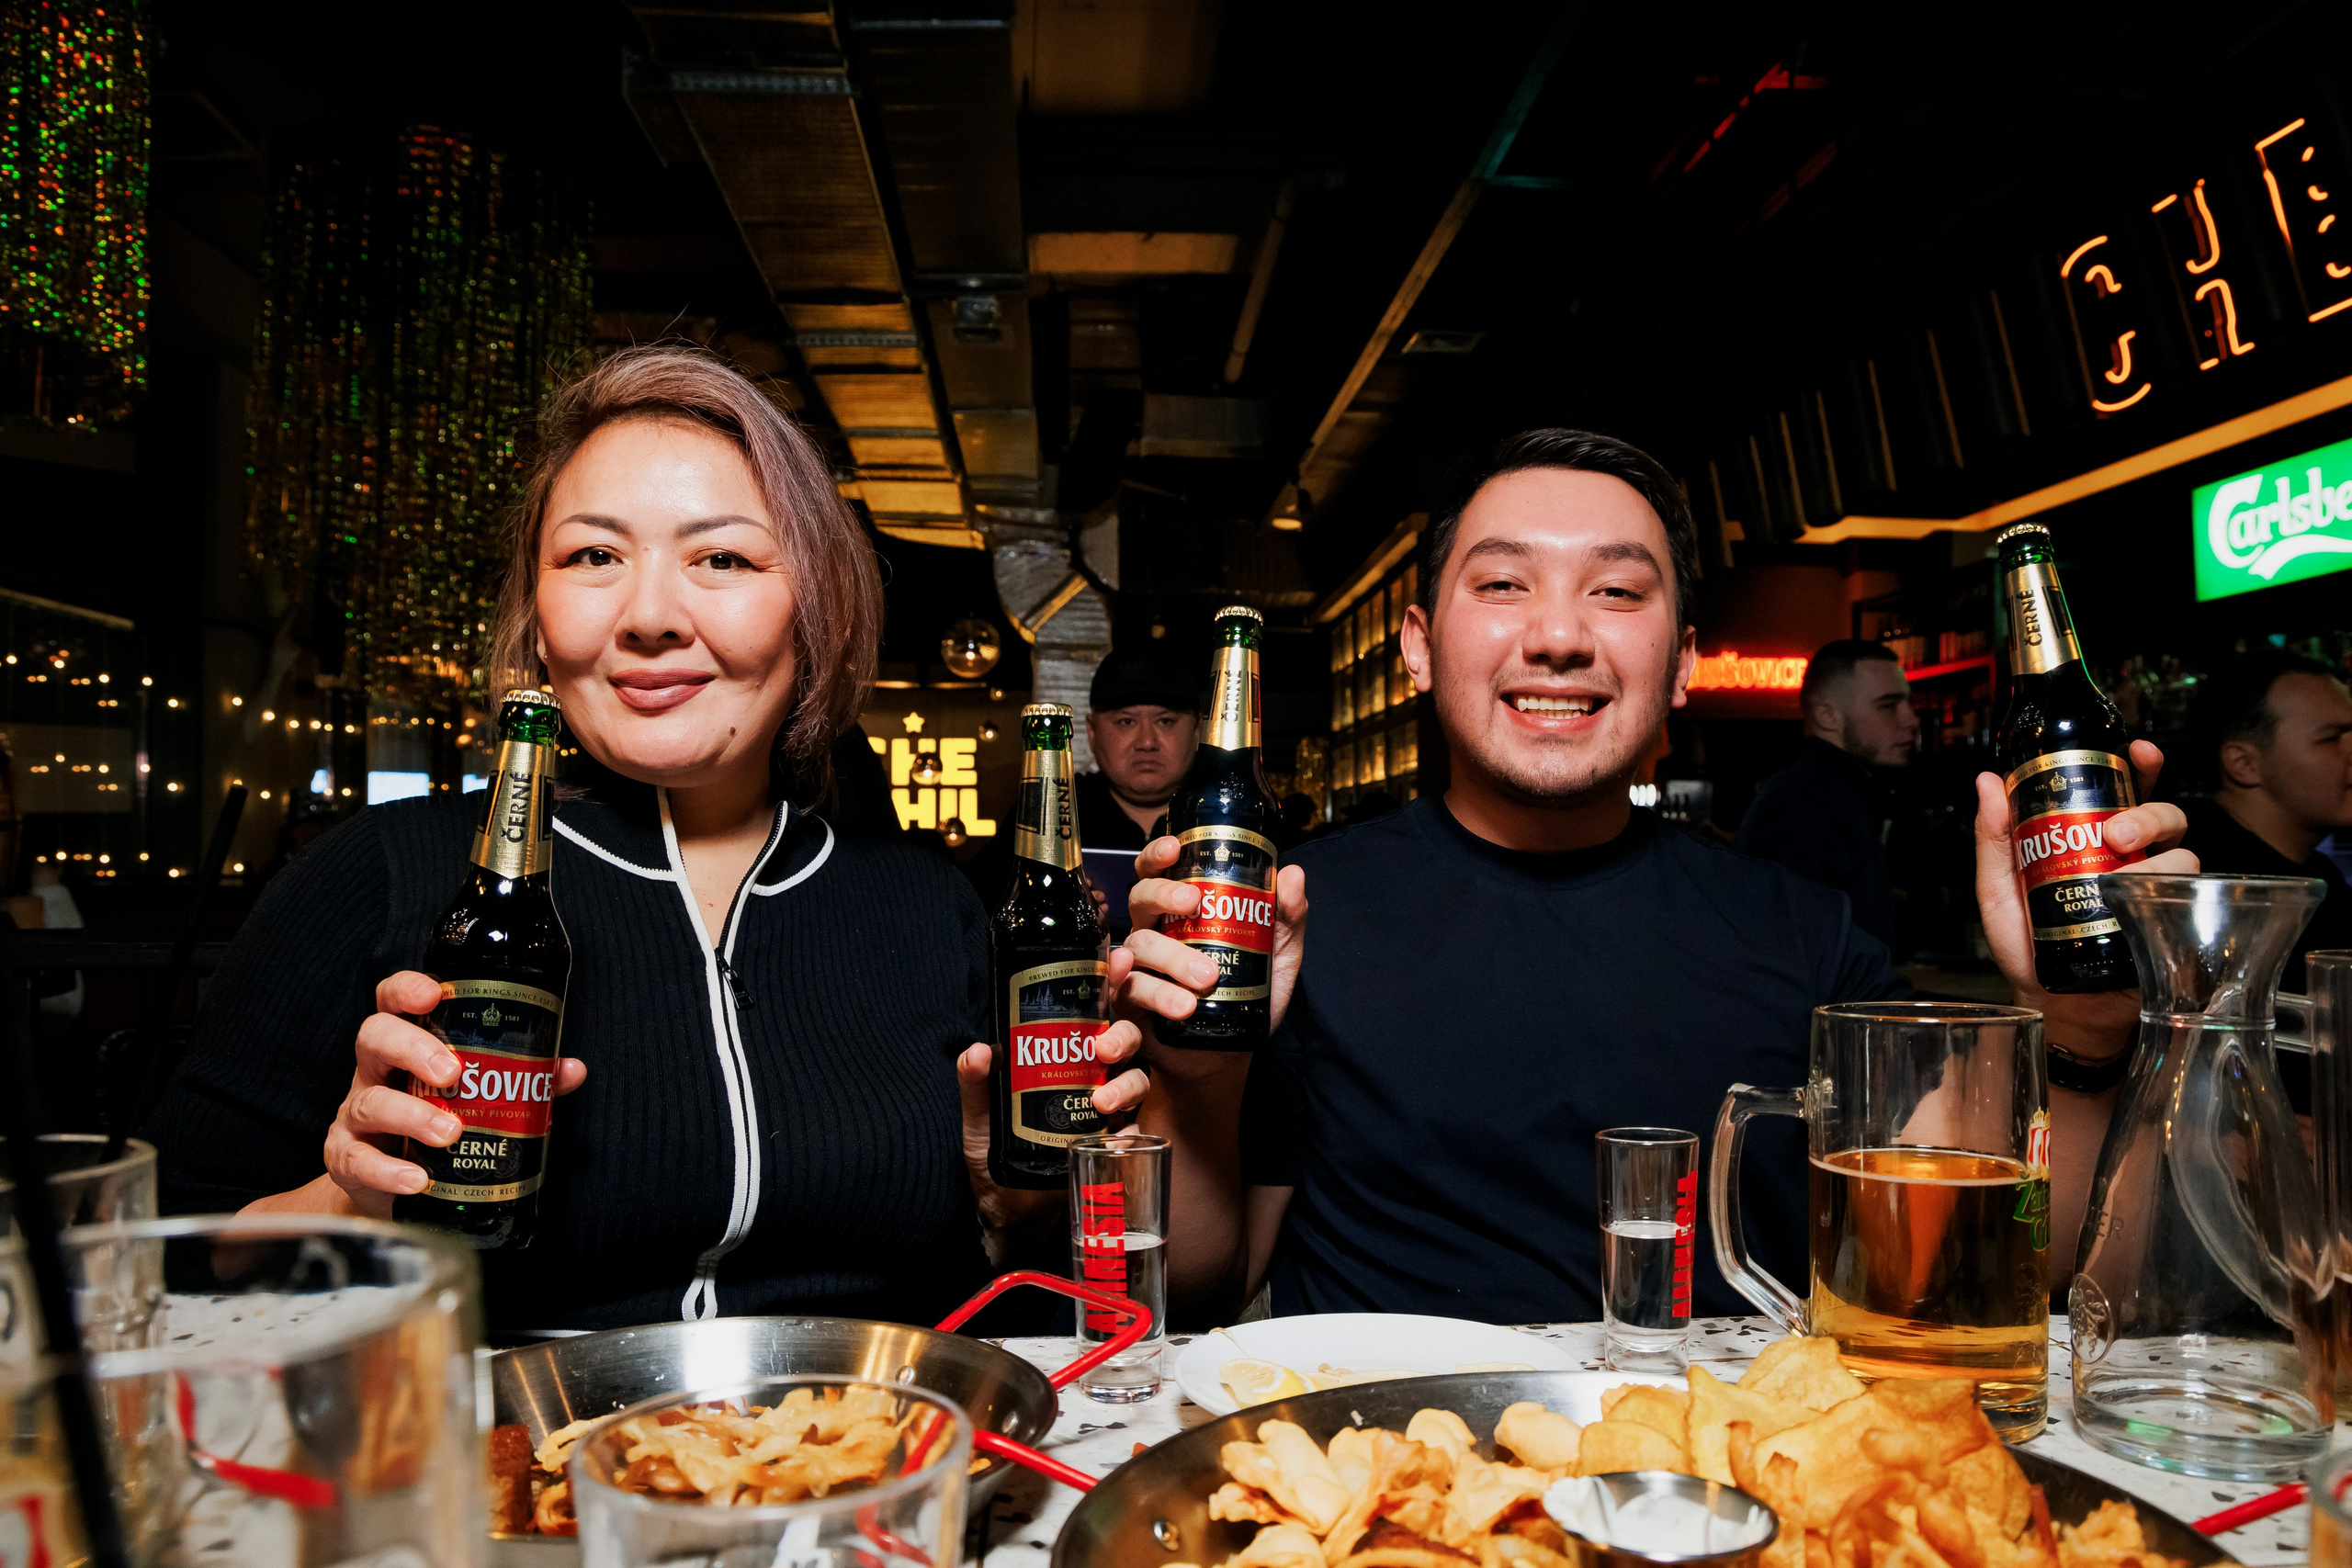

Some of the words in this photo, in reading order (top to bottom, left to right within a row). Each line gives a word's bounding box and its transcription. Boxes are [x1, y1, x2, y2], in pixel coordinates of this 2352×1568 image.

[2208, 467, 2352, 569] Carlsbe
[2015, 589, 2043, 648] ČERNÉ
[867, 736, 978, 786] HE
[501, 771, 532, 843] ČERNÉ
[1054, 777, 1072, 840] ČERNÉ
[2016, 822, 2105, 871] KRUŠOV
[2064, 897, 2105, 913] ROYAL
[442, 988, 459, 997] WED
[462, 987, 481, 995] FOR
[482, 987, 511, 997] KINGS
[513, 991, 537, 1002] SINCE
[489, 1110, 532, 1120] PIVOVAR
[1070, 1110, 1100, 1122] ROYAL
[453, 1157, 498, 1170] ROYAL
[424, 1183, 458, 1196] IGINAL
[463, 1188, 494, 1197] CZECH
[499, 1184, 526, 1195] RECIPE
